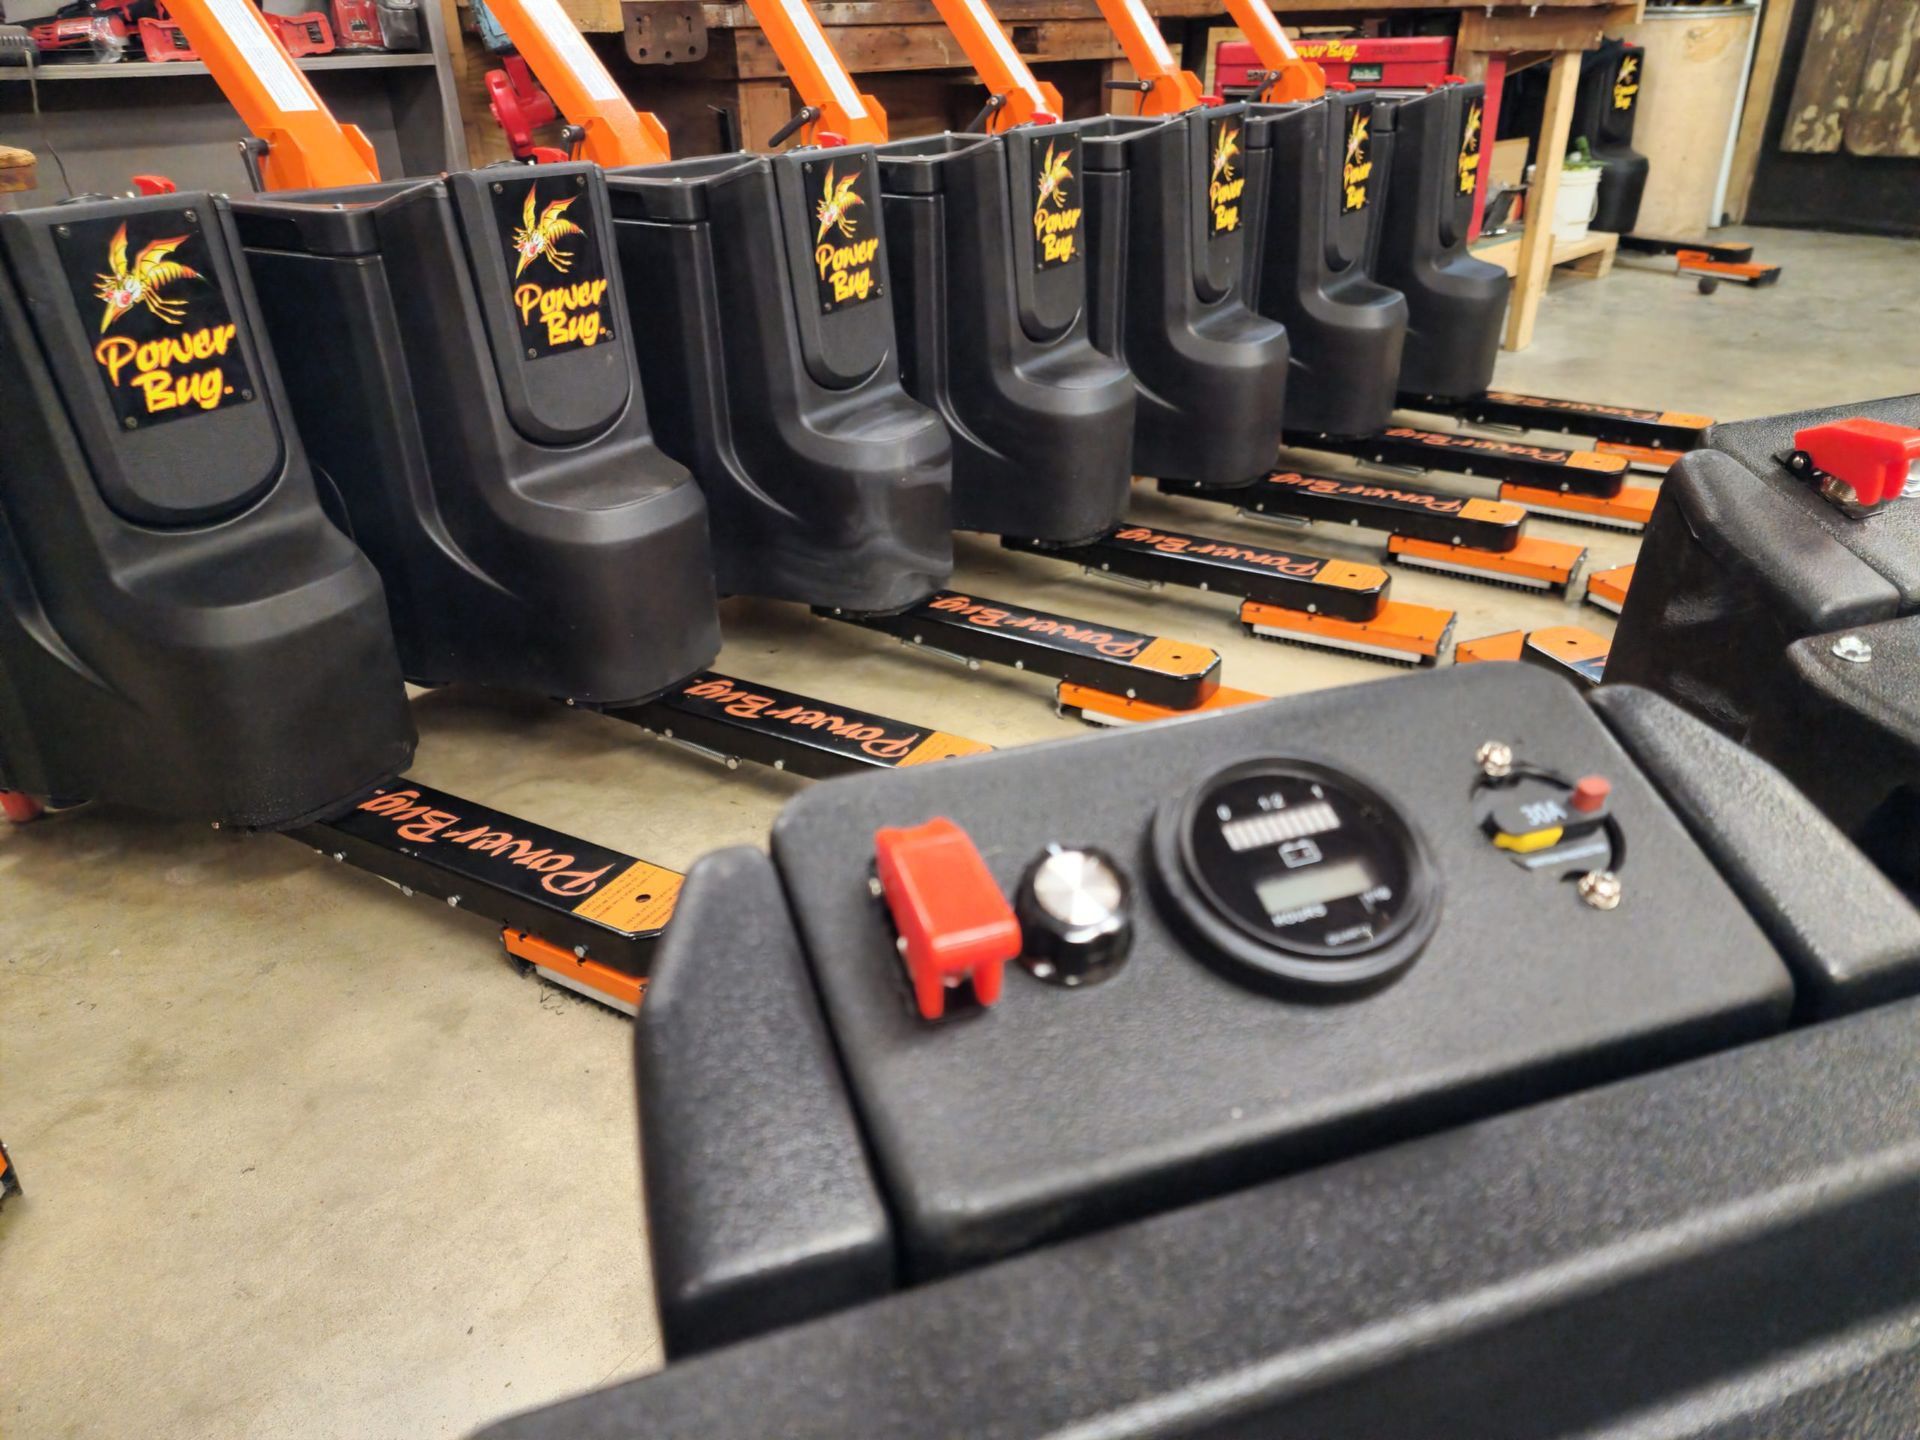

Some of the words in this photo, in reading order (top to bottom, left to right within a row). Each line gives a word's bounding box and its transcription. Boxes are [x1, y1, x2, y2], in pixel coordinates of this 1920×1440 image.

[1210, 178, 1245, 212] Power
[1034, 208, 1082, 241] Power
[815, 238, 879, 281] Power
[514, 279, 608, 326] Power
[96, 323, 236, 387] Power
